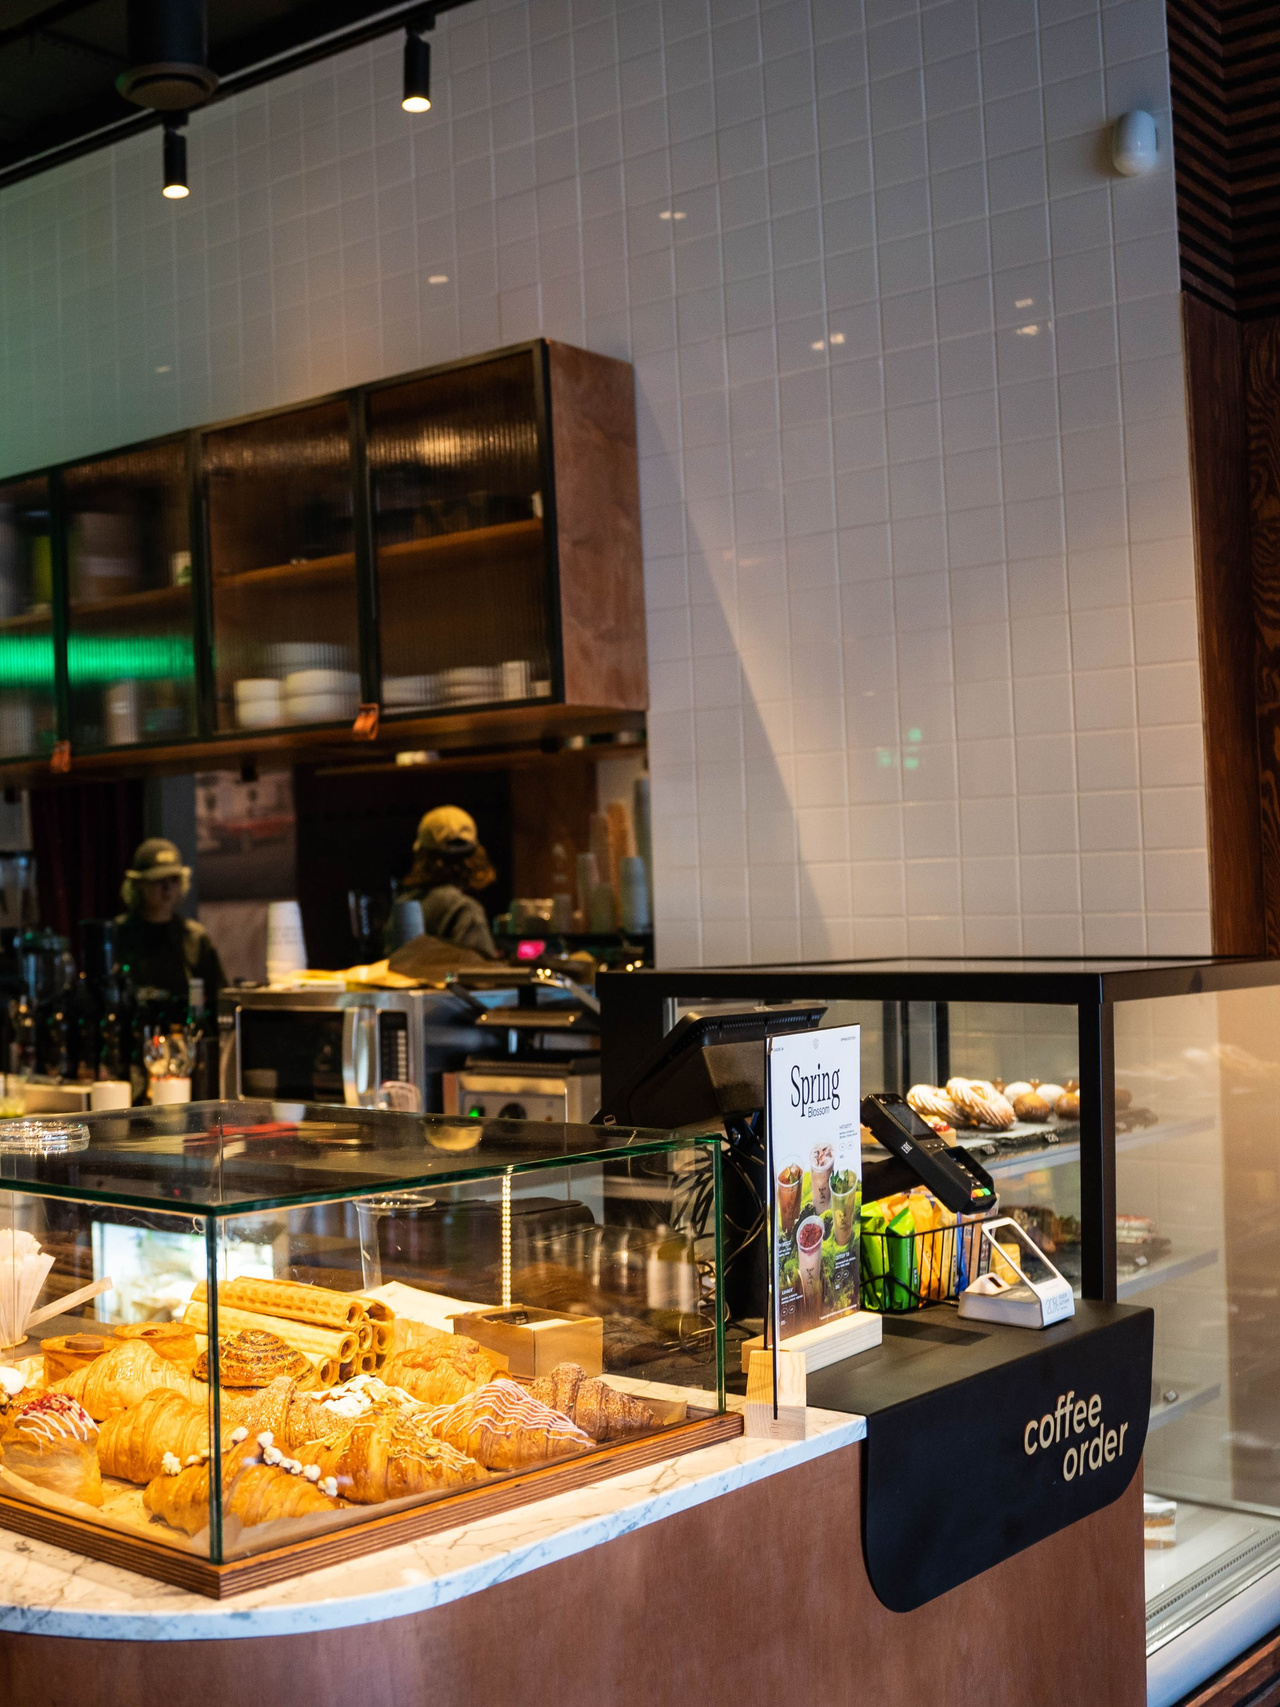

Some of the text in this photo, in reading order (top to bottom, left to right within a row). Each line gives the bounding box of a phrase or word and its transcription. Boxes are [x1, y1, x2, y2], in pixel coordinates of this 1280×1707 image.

[791, 1063, 840, 1117] Spring
[808, 1106, 830, 1118] Blossom
[1024, 1390, 1102, 1455] coffee
[1063, 1422, 1128, 1481] order
